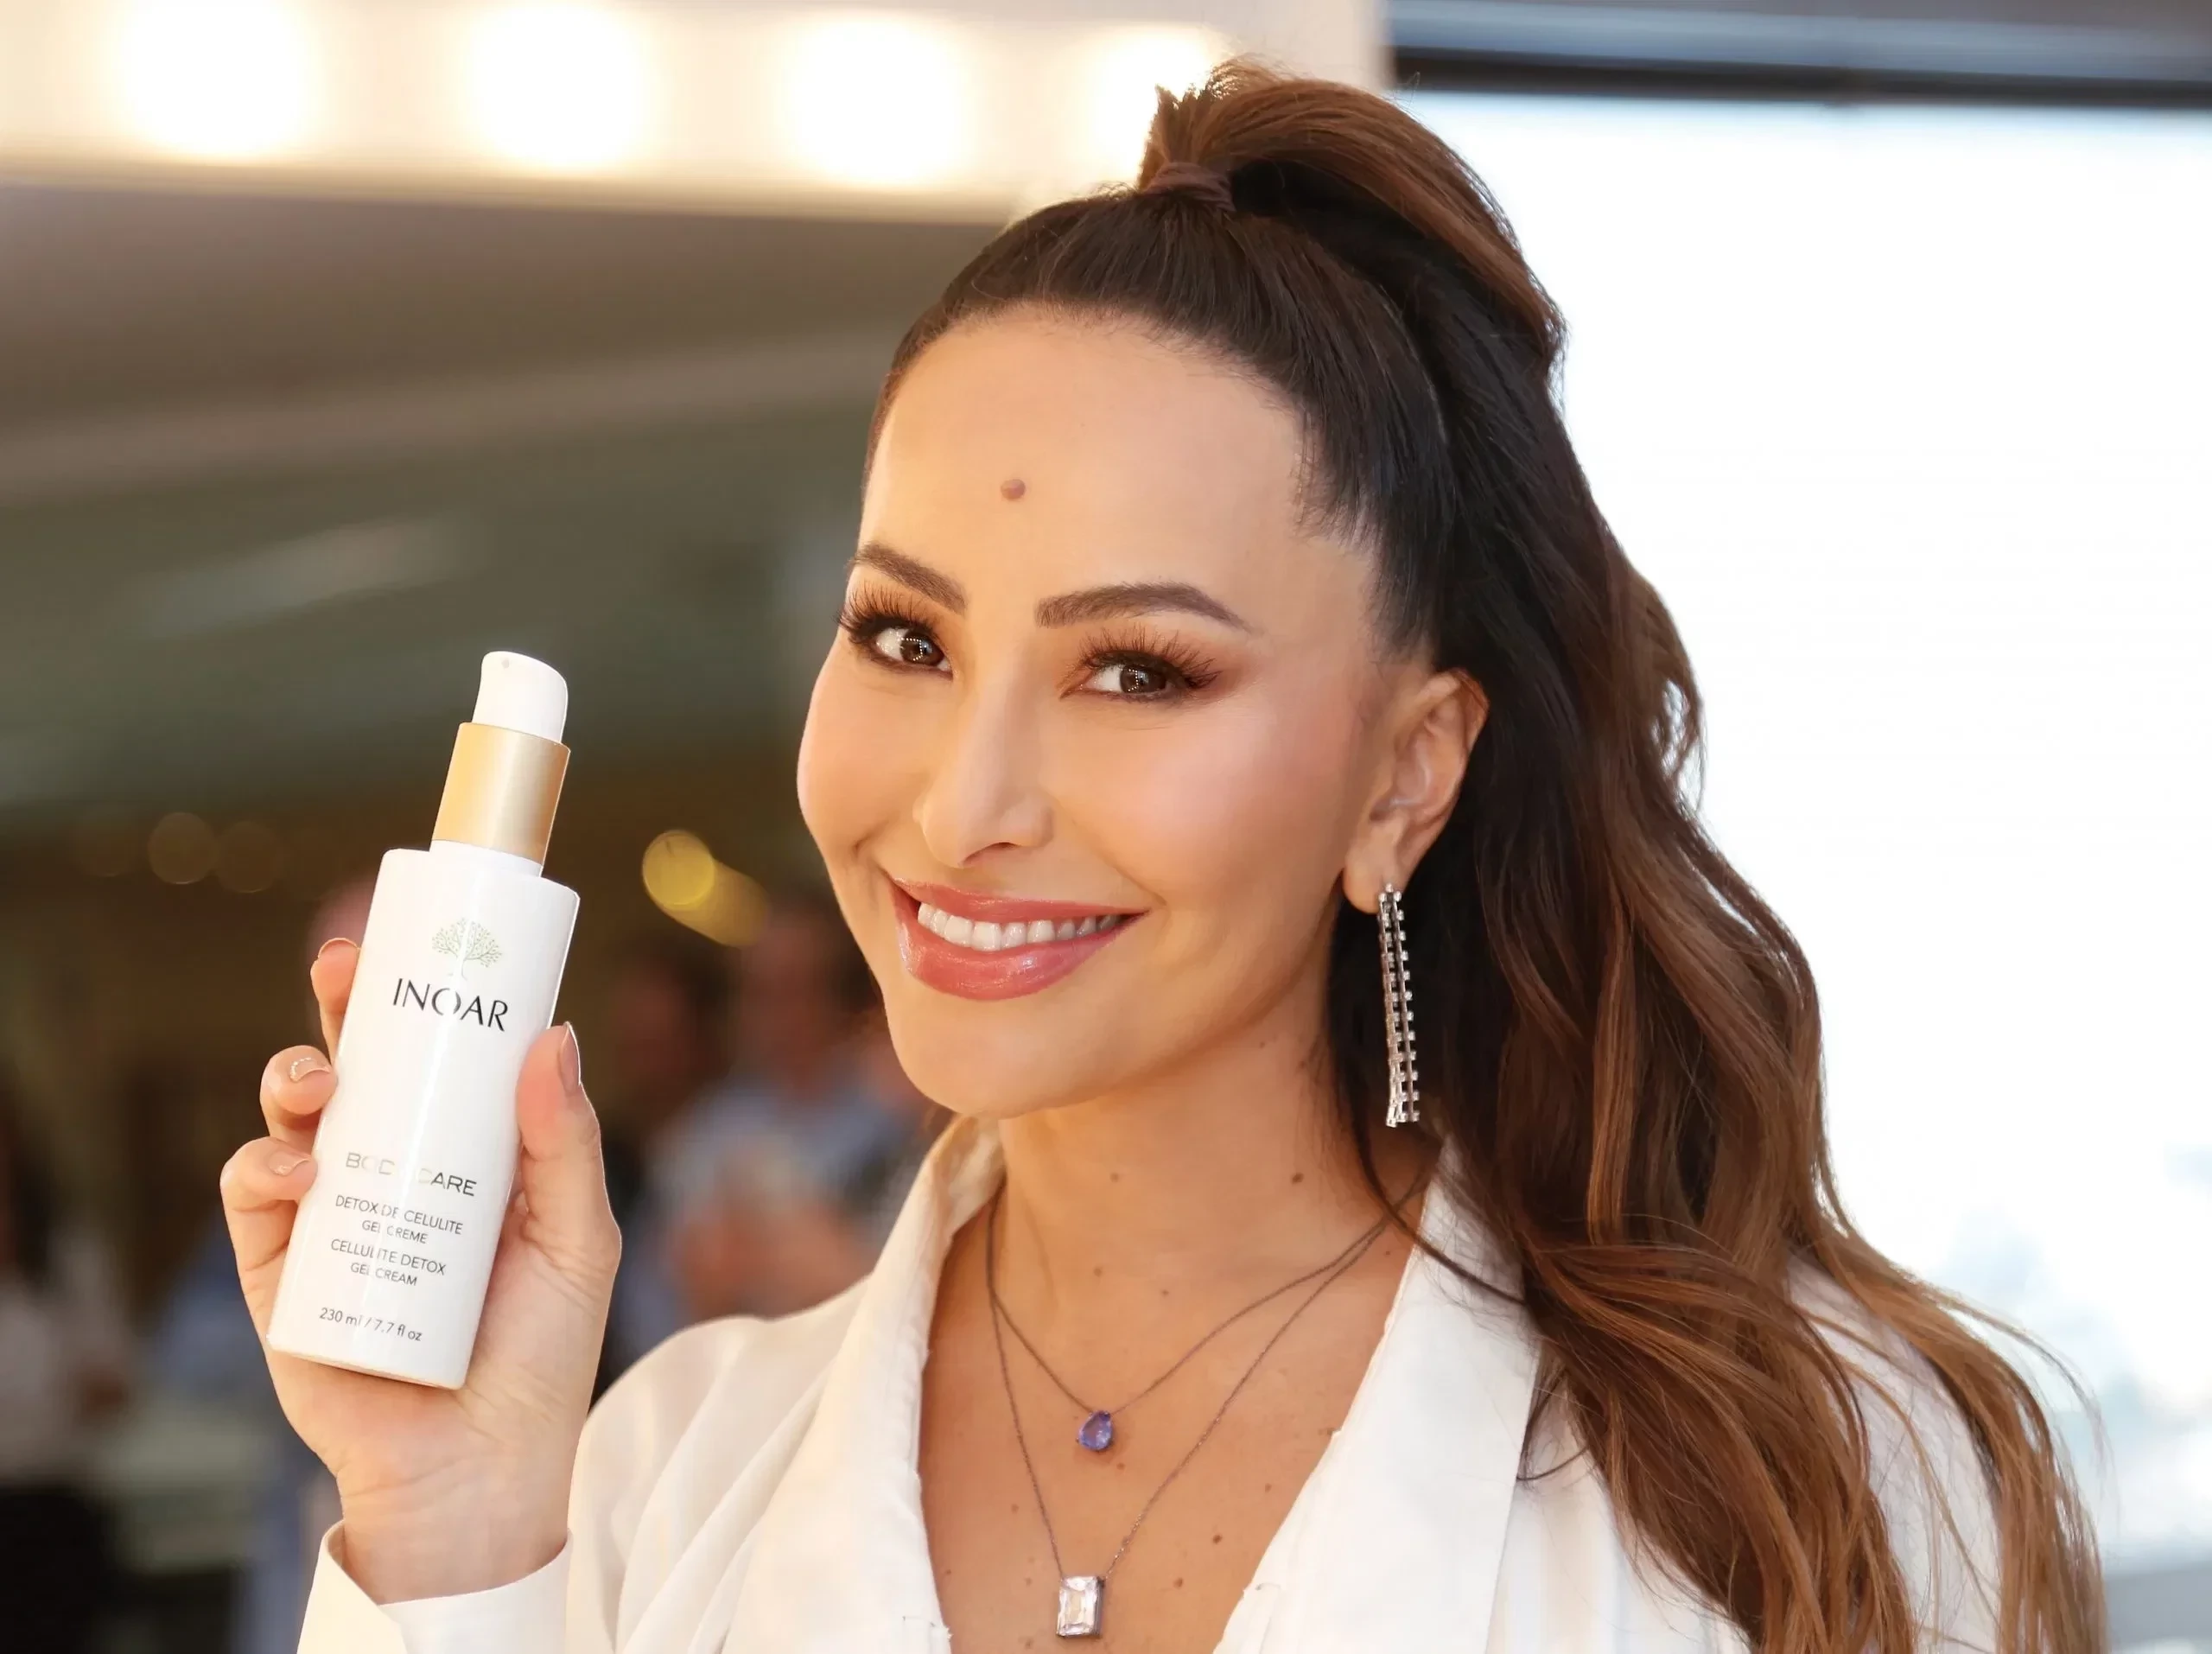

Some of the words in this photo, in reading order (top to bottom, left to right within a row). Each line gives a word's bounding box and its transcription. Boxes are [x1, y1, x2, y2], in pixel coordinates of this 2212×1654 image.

[392, 977, 509, 1032] INOAR
[416, 1168, 477, 1197] CARE
[335, 1194, 378, 1214] DETOX
[404, 1210, 463, 1235] CELULITE
[386, 1225, 428, 1244] CREME
[331, 1238, 397, 1263] CELLULITE
[400, 1254, 446, 1276] DETOX
[375, 1267, 417, 1286] CREAM
[320, 1307, 343, 1323] 230
[346, 1314, 363, 1327] ml
[374, 1319, 394, 1334] 7.7
[397, 1324, 405, 1338] fl
[408, 1329, 423, 1341] oz
